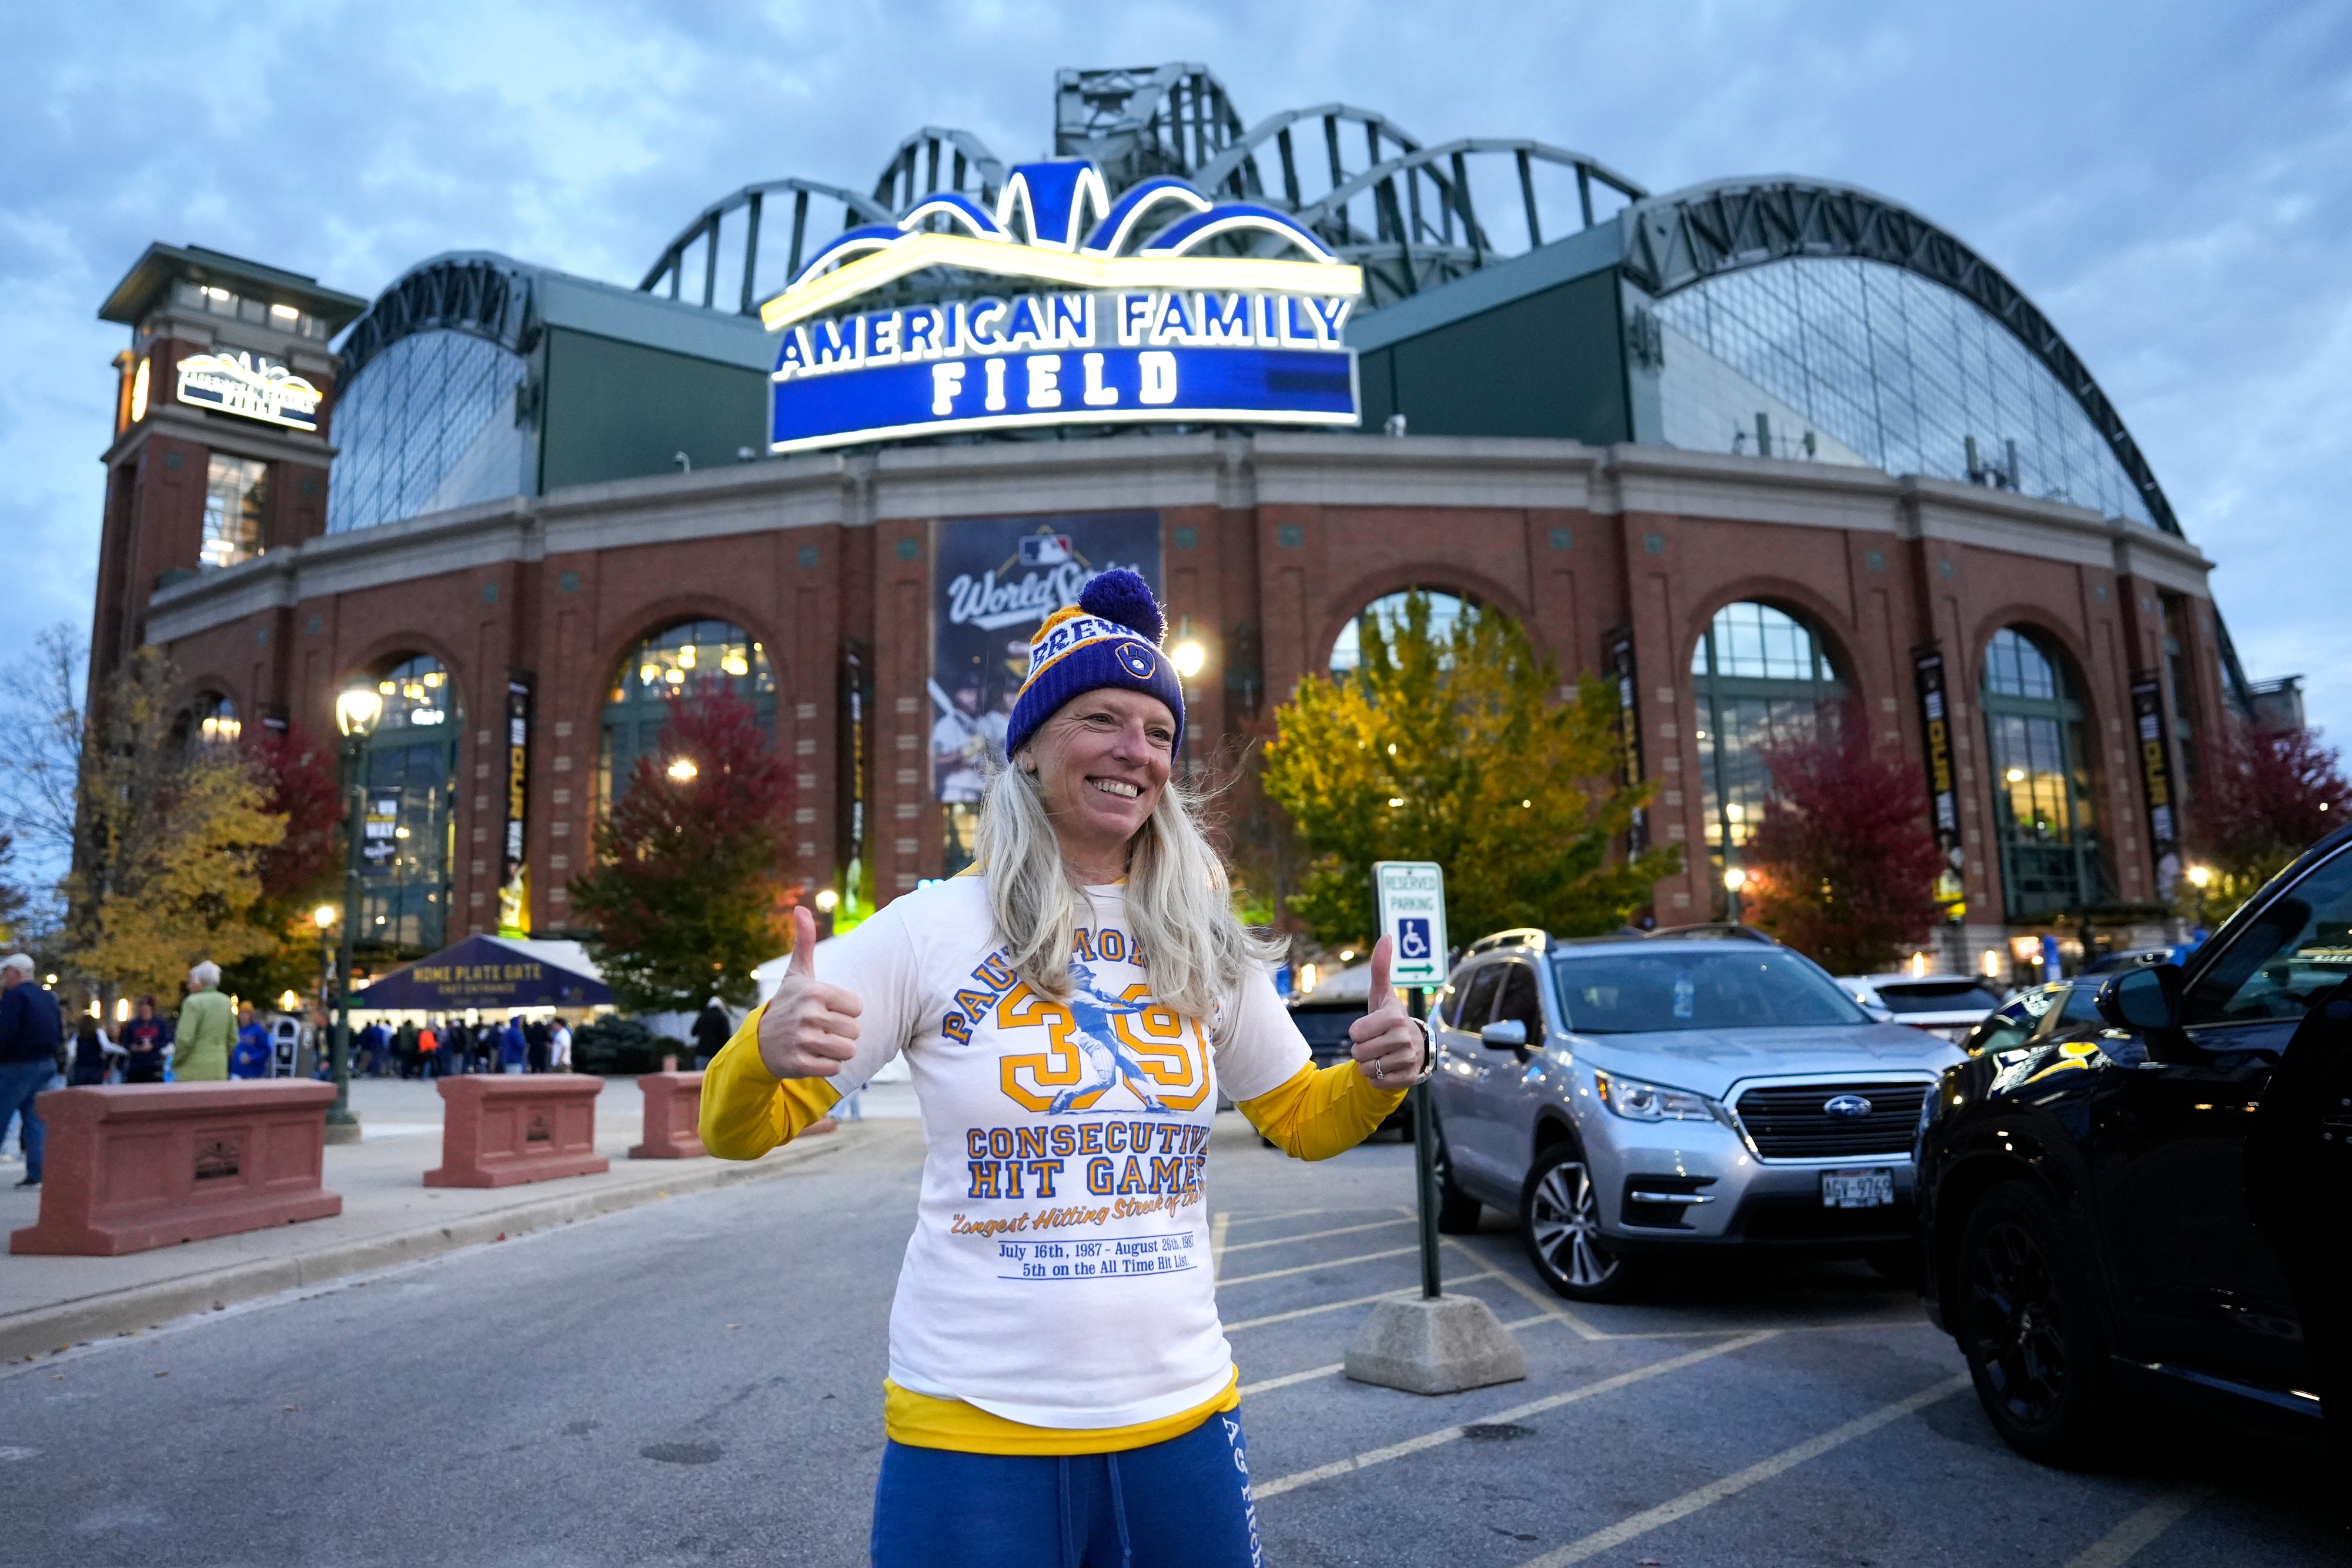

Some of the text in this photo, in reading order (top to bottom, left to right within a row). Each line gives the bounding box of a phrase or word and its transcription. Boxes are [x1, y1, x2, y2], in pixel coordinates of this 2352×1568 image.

[772, 293, 1351, 382] AMERICAN FAMILY
[931, 351, 1177, 416] FIELD
[947, 565, 1056, 626] World
[1030, 618, 1136, 675] BREW
[1385, 875, 1436, 890] RESERVED
[1391, 897, 1434, 911] PARKING
[413, 962, 542, 983] HOME PLATE GATE
[941, 945, 1018, 1046] PAU
[997, 979, 1211, 1113] 39
[968, 1158, 1064, 1199] HIT
[951, 1213, 1030, 1238] "Longest
[1032, 1205, 1110, 1230] Hitting
[1111, 1192, 1164, 1219] Streak
[1164, 1188, 1183, 1218] of
[1181, 1189, 1198, 1207] the
[999, 1244, 1027, 1261] July
[1034, 1243, 1070, 1259] 16th,
[1075, 1243, 1102, 1257] 1987
[1115, 1240, 1158, 1257] August
[1162, 1237, 1182, 1251] 26th,
[1182, 1235, 1194, 1248] 1987
[1023, 1263, 1047, 1277] 5th
[1053, 1265, 1070, 1276] on
[1074, 1262, 1095, 1276] the
[1100, 1260, 1117, 1274] All
[1122, 1259, 1154, 1273] Time
[1158, 1256, 1172, 1270] Hit
[1222, 1416, 1240, 1447] A
